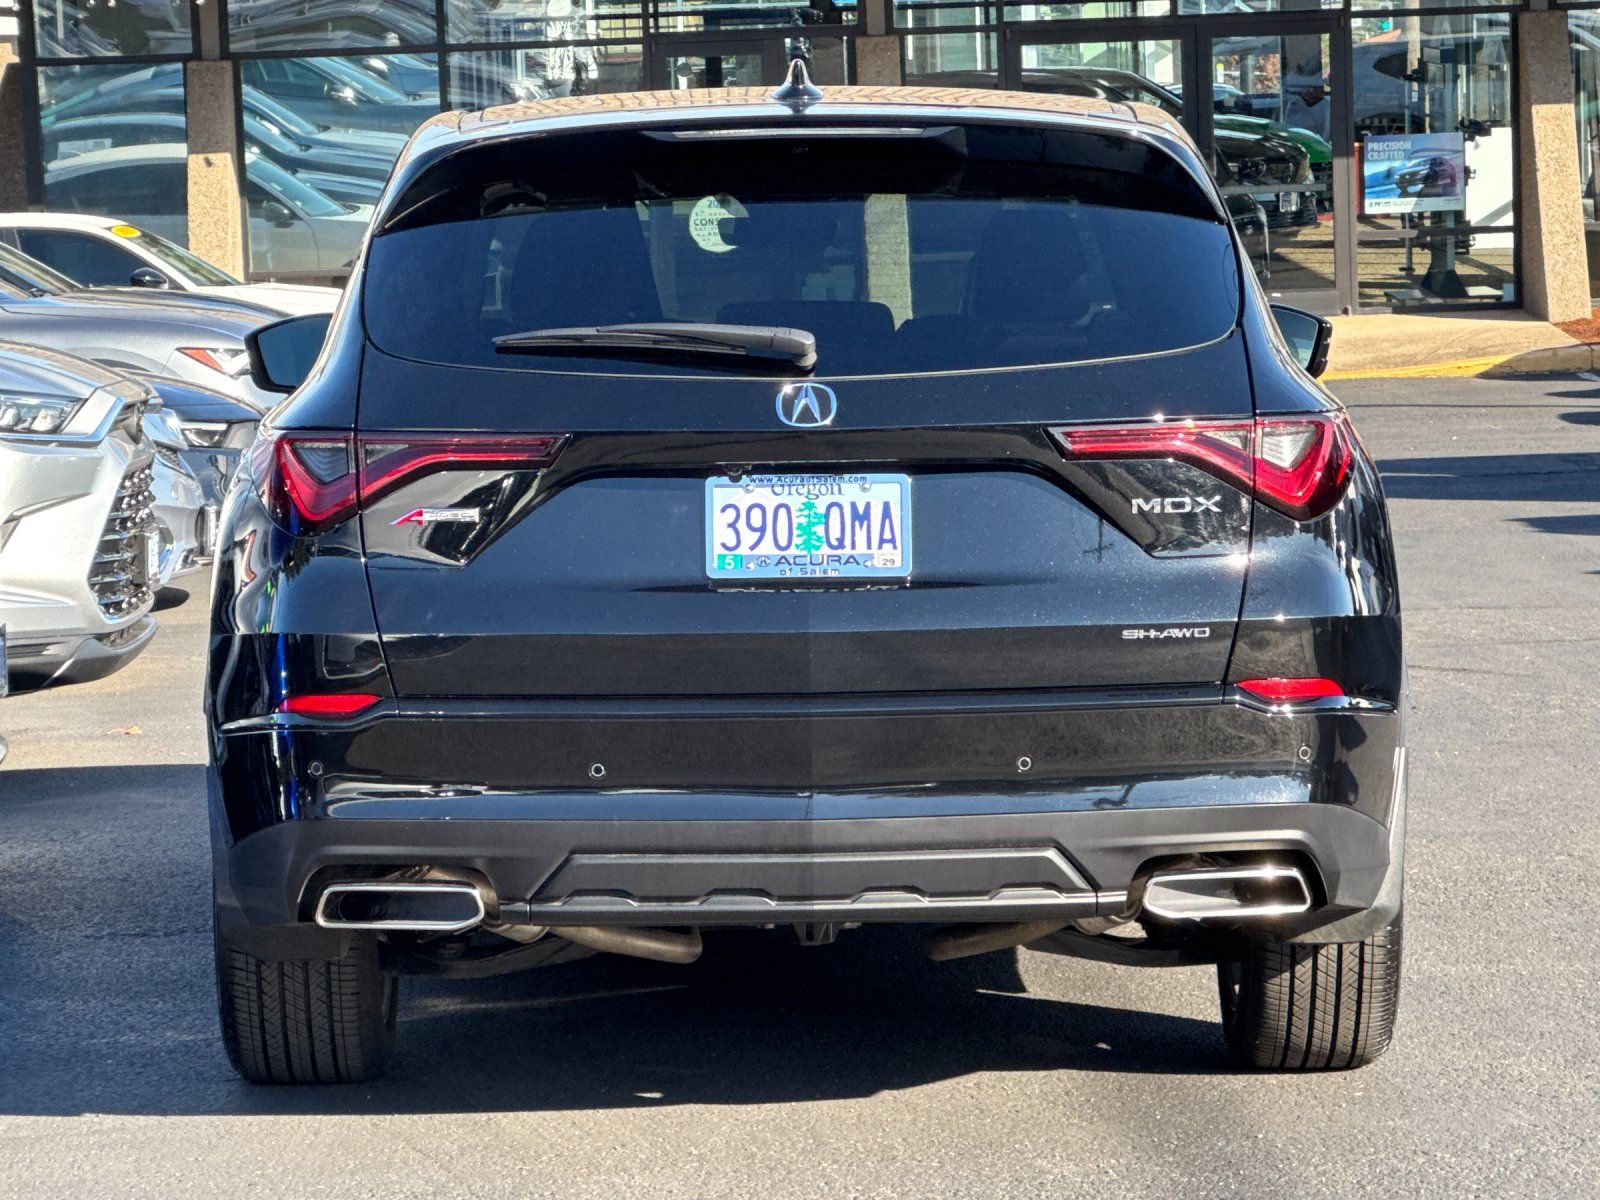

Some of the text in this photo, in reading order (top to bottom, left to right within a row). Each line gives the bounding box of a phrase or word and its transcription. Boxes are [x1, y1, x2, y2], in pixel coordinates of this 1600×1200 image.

[1367, 140, 1412, 152] PRECISION
[1367, 150, 1405, 161] CRAFTED
[770, 483, 844, 501] Oregon
[1131, 495, 1222, 515] MDX
[719, 501, 898, 552] 390 QMA
[774, 555, 861, 567] ACURA
[881, 558, 896, 567] 29
[779, 567, 840, 577] of Salem
